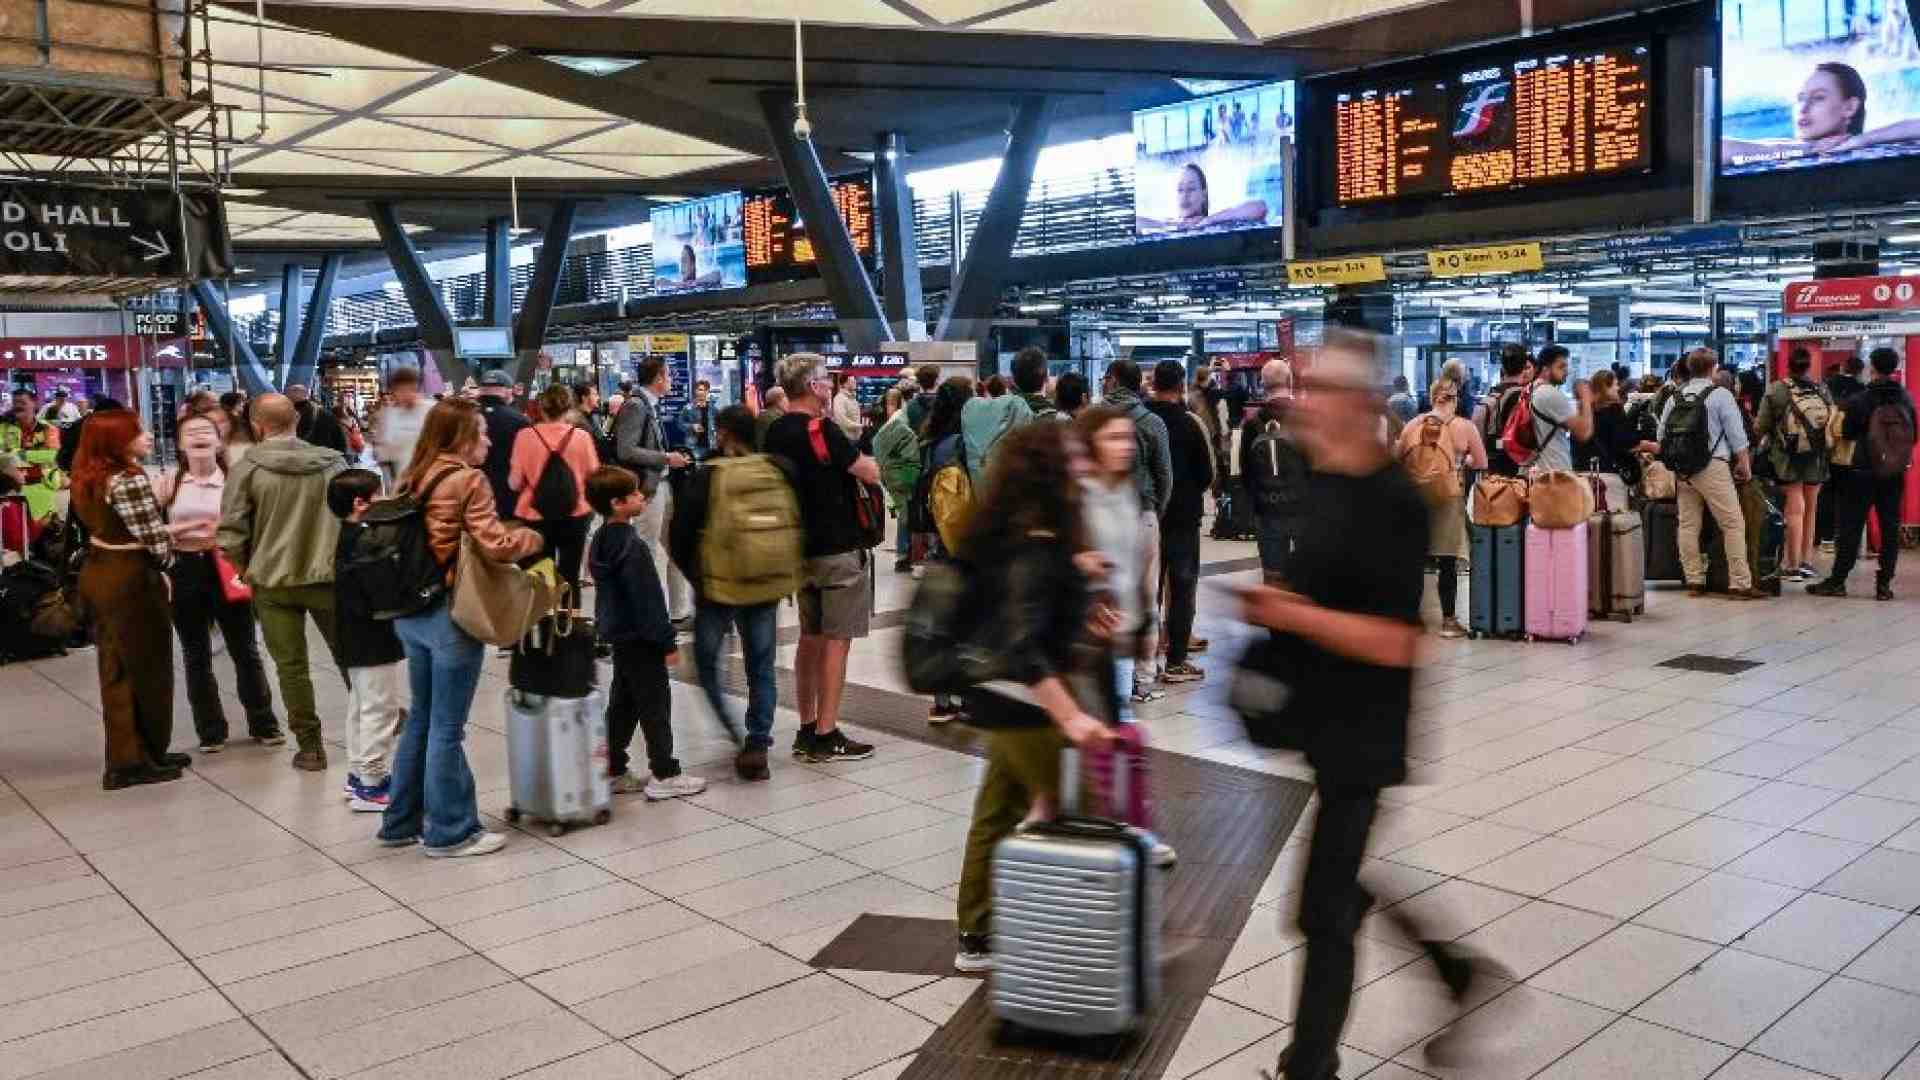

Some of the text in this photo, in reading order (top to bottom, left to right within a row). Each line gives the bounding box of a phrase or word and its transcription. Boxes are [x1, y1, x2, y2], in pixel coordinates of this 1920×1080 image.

[40, 203, 131, 227] HALL
[136, 313, 178, 324] FOOD
[136, 325, 176, 334] HALL
[20, 344, 107, 361] TICKETS
